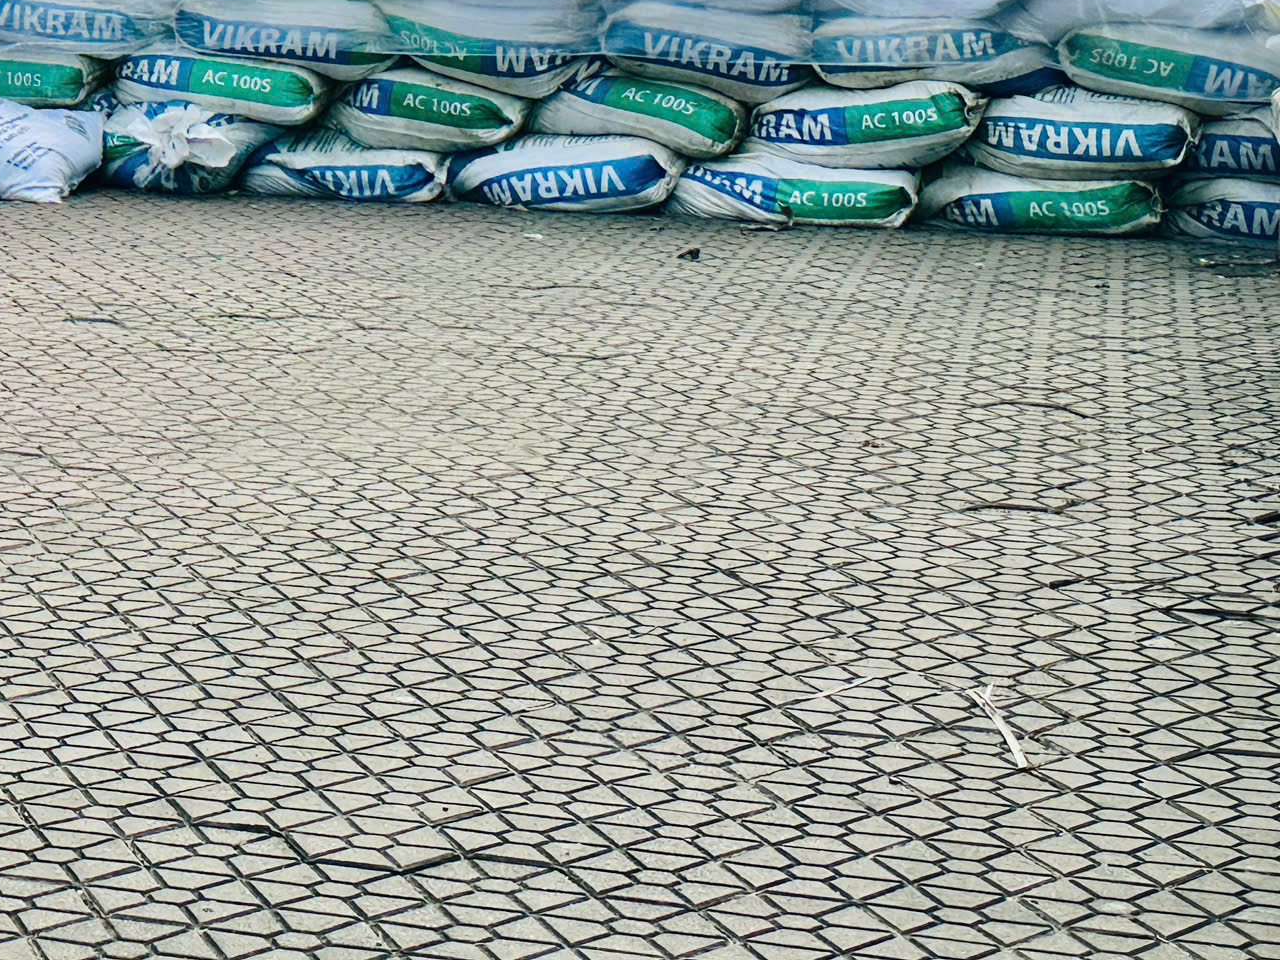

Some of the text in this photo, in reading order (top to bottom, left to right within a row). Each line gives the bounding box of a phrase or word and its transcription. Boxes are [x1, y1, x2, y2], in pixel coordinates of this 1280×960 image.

[203, 20, 338, 60] VIKRAM
[837, 31, 996, 64] VIKRAM
[644, 31, 790, 82] VIKRAM
[1088, 47, 1137, 70] 100S
[1143, 58, 1175, 78] AC
[7, 70, 41, 87] 100S
[201, 69, 228, 86] AC
[231, 73, 272, 93] 100S
[402, 93, 472, 117] AC 100S
[621, 87, 699, 115] AC 100S
[753, 107, 939, 141] RAM AC 100S
[986, 121, 1144, 158] VIKRAM
[483, 165, 627, 206] VIKRAM
[788, 190, 868, 208] AC 100S
[1029, 200, 1057, 217] AC
[1060, 199, 1111, 218] 100S
